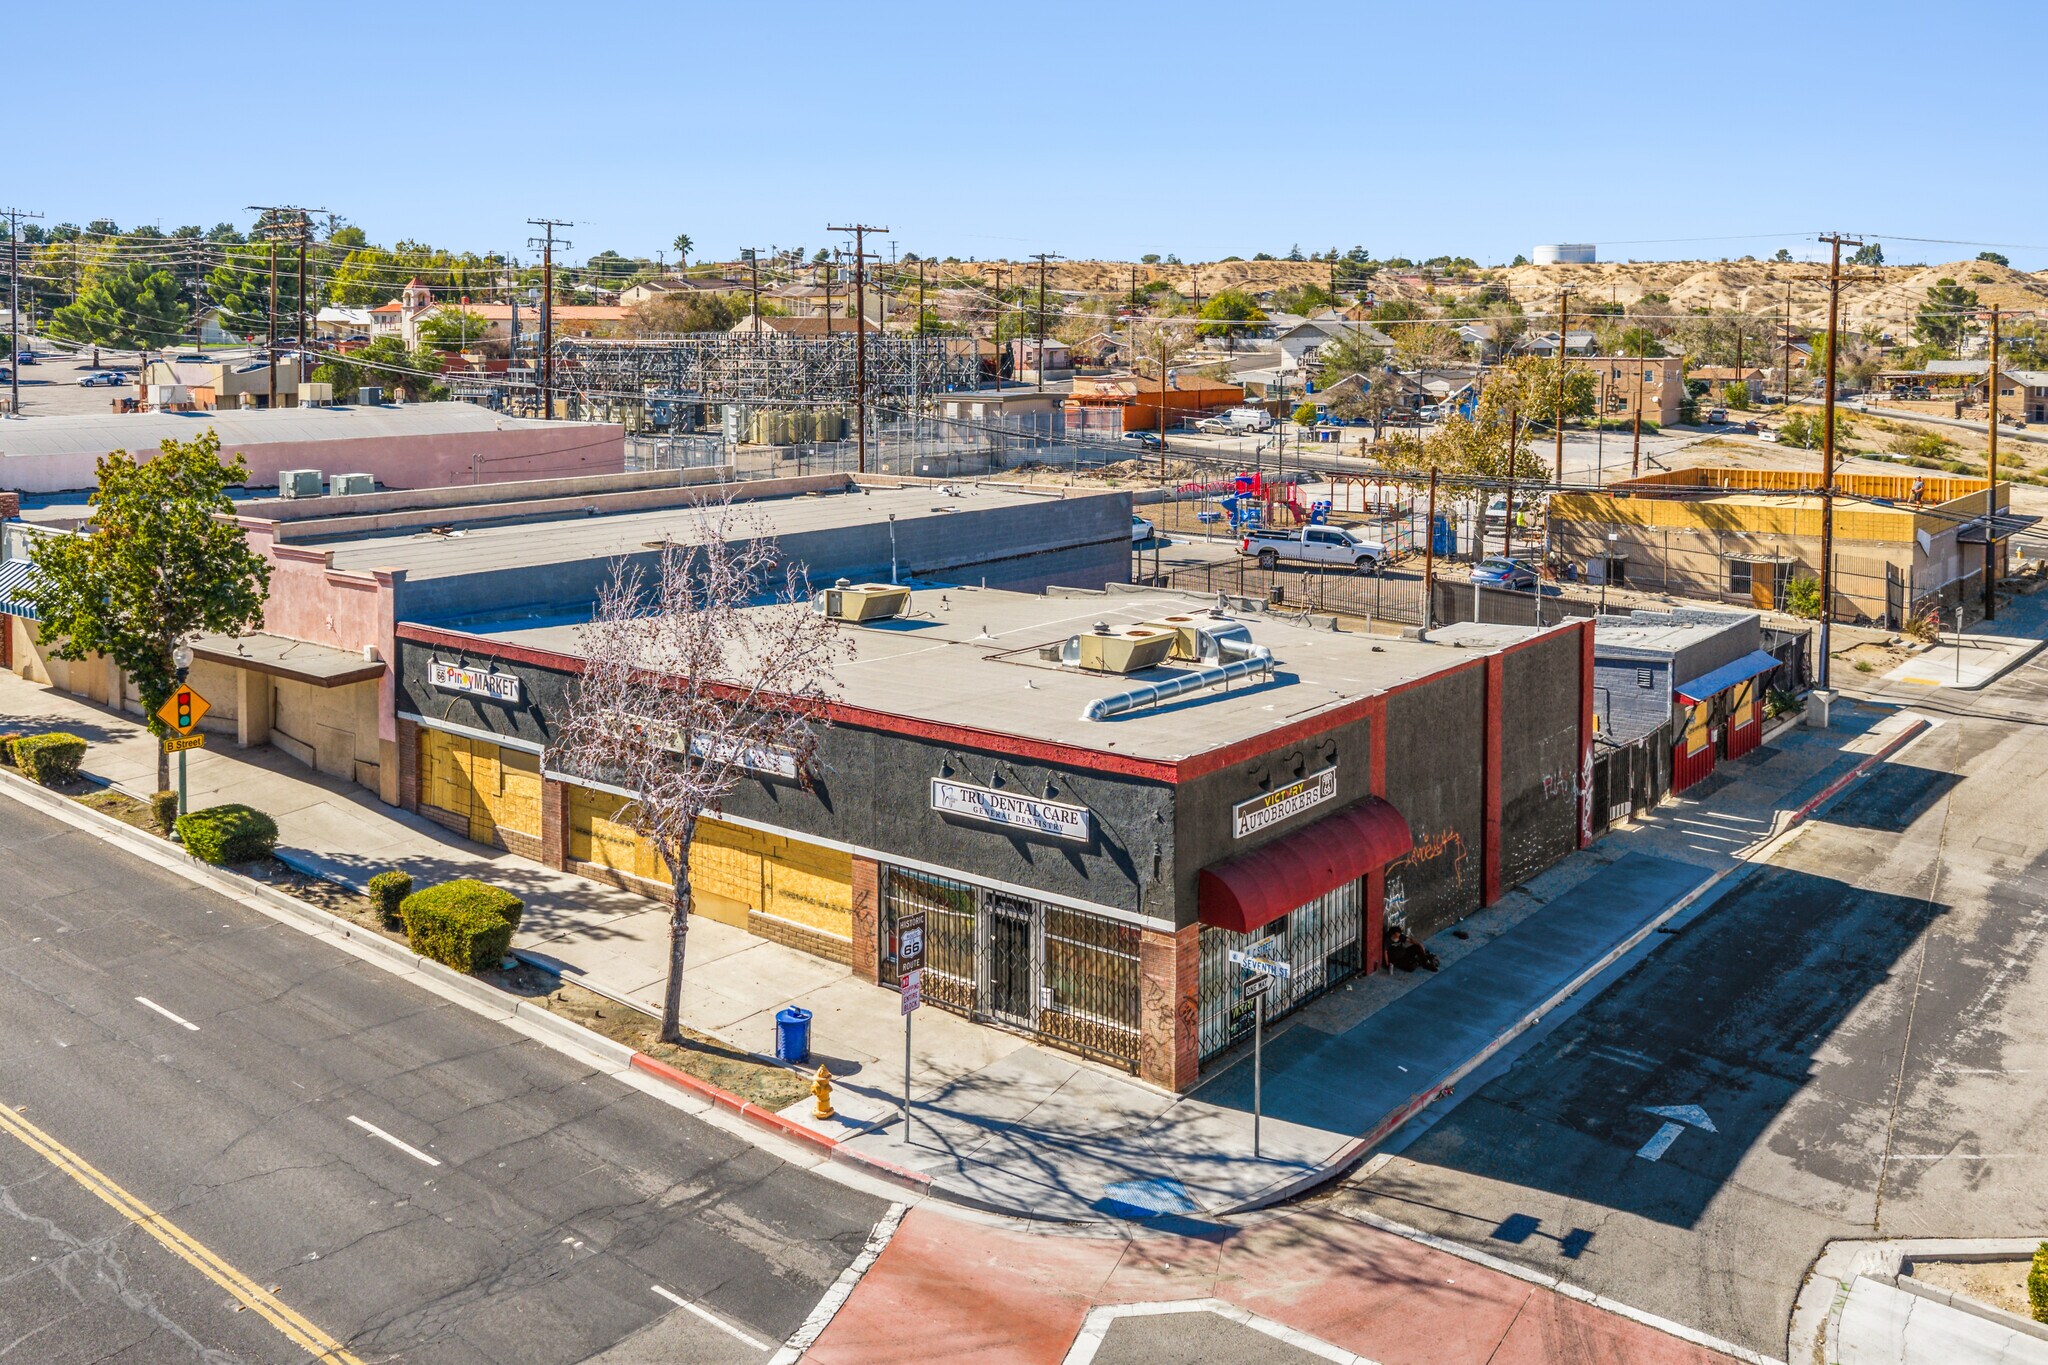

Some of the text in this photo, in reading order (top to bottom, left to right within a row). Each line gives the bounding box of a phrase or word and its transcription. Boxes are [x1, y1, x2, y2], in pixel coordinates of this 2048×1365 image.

[167, 738, 201, 751] B Street
[960, 789, 1079, 825] TRU DENTAL CARE
[973, 807, 1065, 832] GENERAL DENTISTRY
[900, 915, 924, 929] HISTORIC
[904, 942, 920, 955] 66
[1257, 940, 1274, 953] STREET
[902, 959, 920, 971] ROUTE
[1243, 959, 1276, 976] SEVENTH
[1279, 967, 1289, 979] ST
[1247, 980, 1268, 995] ONE WAY
[903, 1001, 918, 1012] BLOCK
